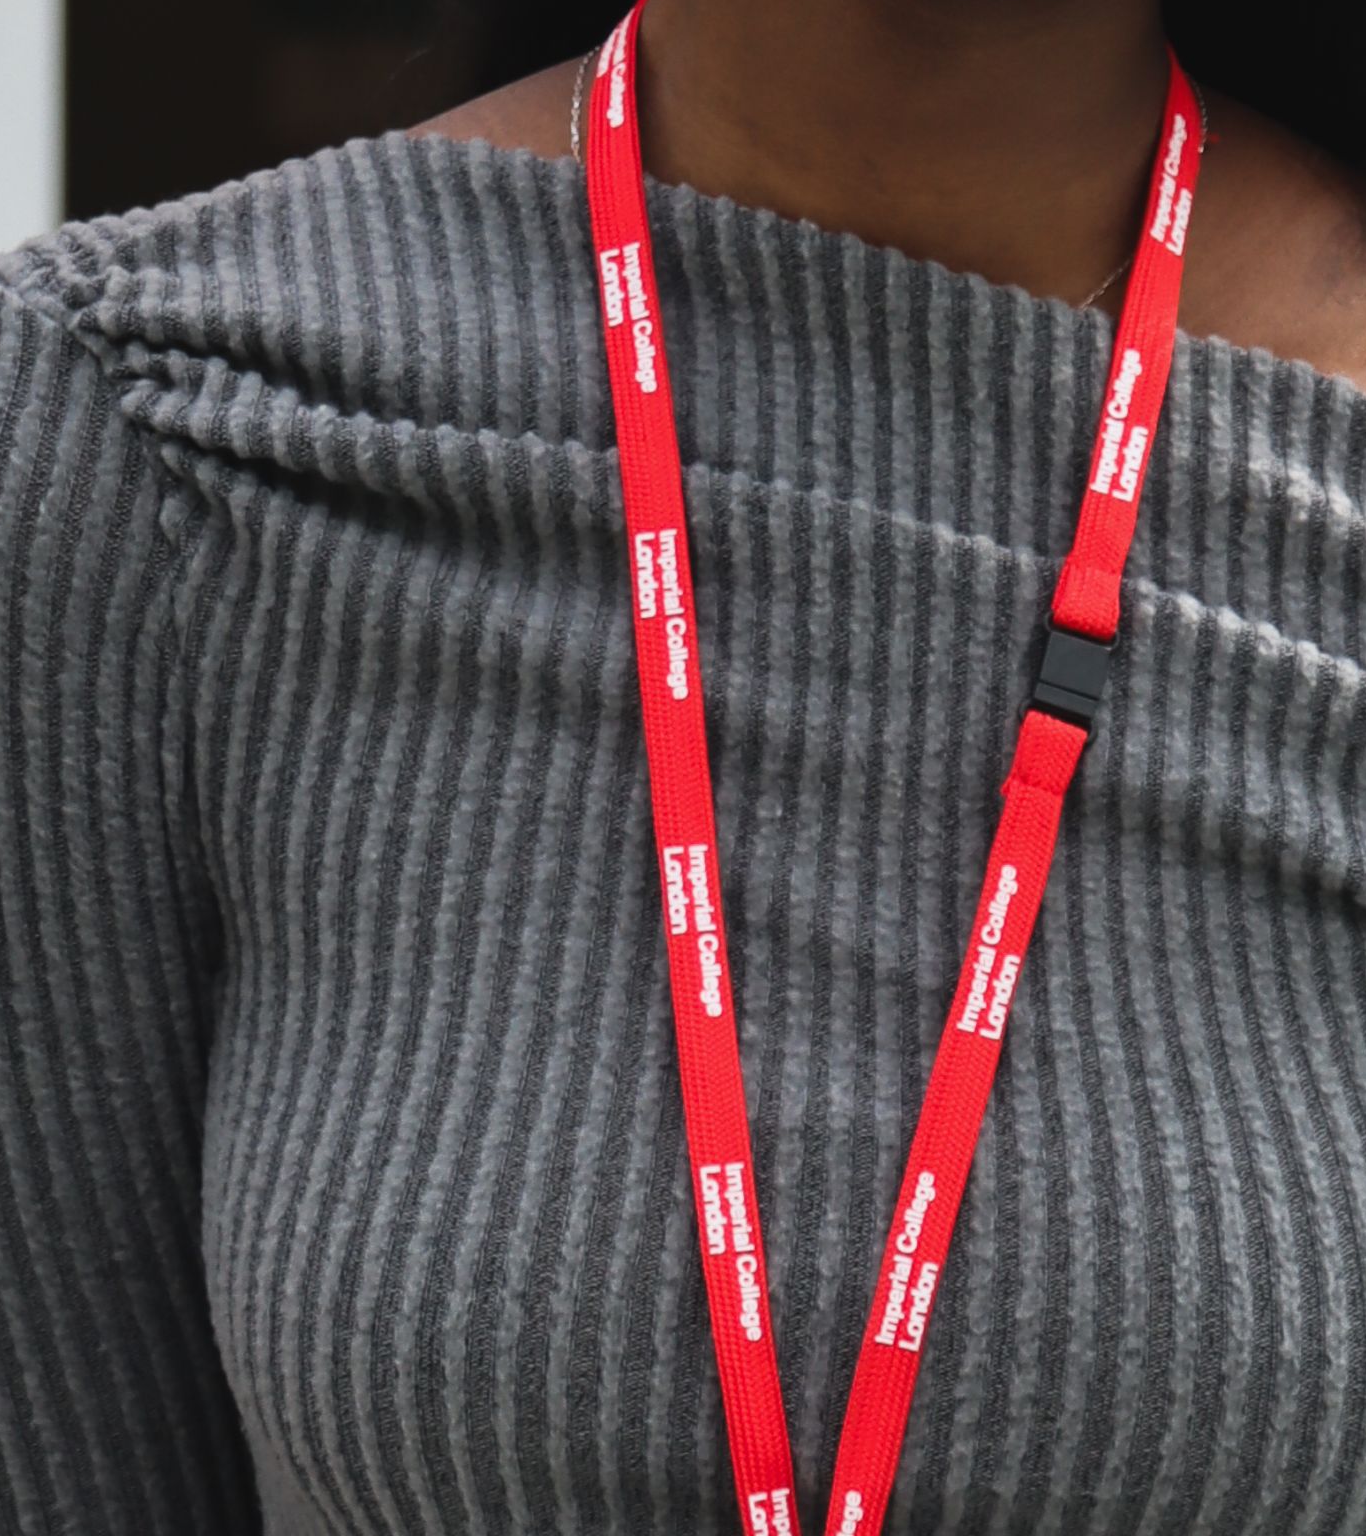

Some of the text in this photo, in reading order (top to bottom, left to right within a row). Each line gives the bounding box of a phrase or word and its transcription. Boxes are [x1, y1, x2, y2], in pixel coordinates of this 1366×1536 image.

[1150, 172, 1176, 242] Imperial
[1165, 187, 1192, 256] London
[600, 248, 625, 327] London
[622, 241, 657, 393] Imperial College
[1090, 348, 1142, 494] Imperial College
[1112, 426, 1149, 502] London
[635, 532, 659, 619] London
[657, 528, 688, 700] Imperial College
[663, 845, 690, 935] London
[687, 844, 722, 1017] Imperial College
[956, 864, 1018, 1032] Imperial College
[979, 954, 1021, 1040] London
[700, 1164, 727, 1255] London
[724, 1162, 762, 1341] Imperial College
[875, 1171, 935, 1345] Imperial College
[898, 1261, 939, 1352] London
